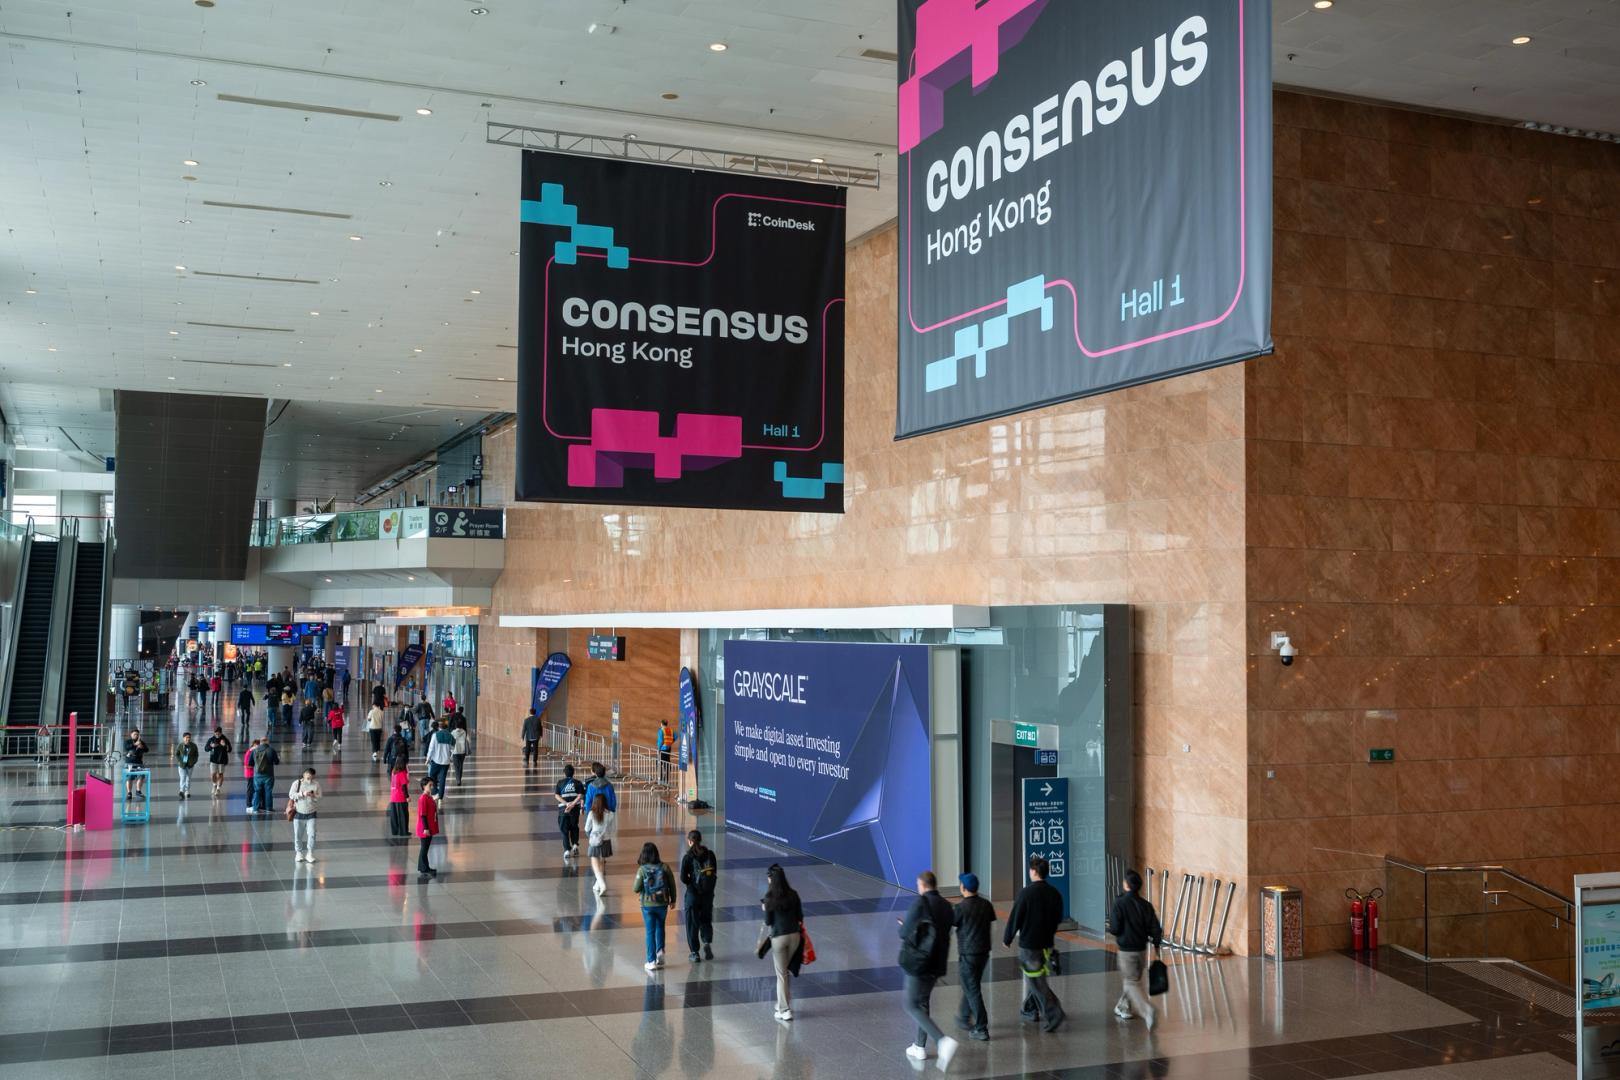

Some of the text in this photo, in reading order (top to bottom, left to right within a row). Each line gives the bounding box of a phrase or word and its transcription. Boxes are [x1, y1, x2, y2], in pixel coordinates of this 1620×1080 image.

[763, 215, 815, 232] CoinDesk
[927, 180, 1052, 265] Hong Kong
[1121, 274, 1185, 322] Hall 1
[562, 336, 693, 368] Hong Kong
[763, 424, 801, 438] Hall 1
[435, 526, 448, 534] 2/F
[733, 669, 808, 704] GRAYSCALE
[734, 720, 841, 759] We make digital asset investing
[1016, 730, 1027, 740] EXIT
[734, 741, 850, 780] simple and open to every investor
